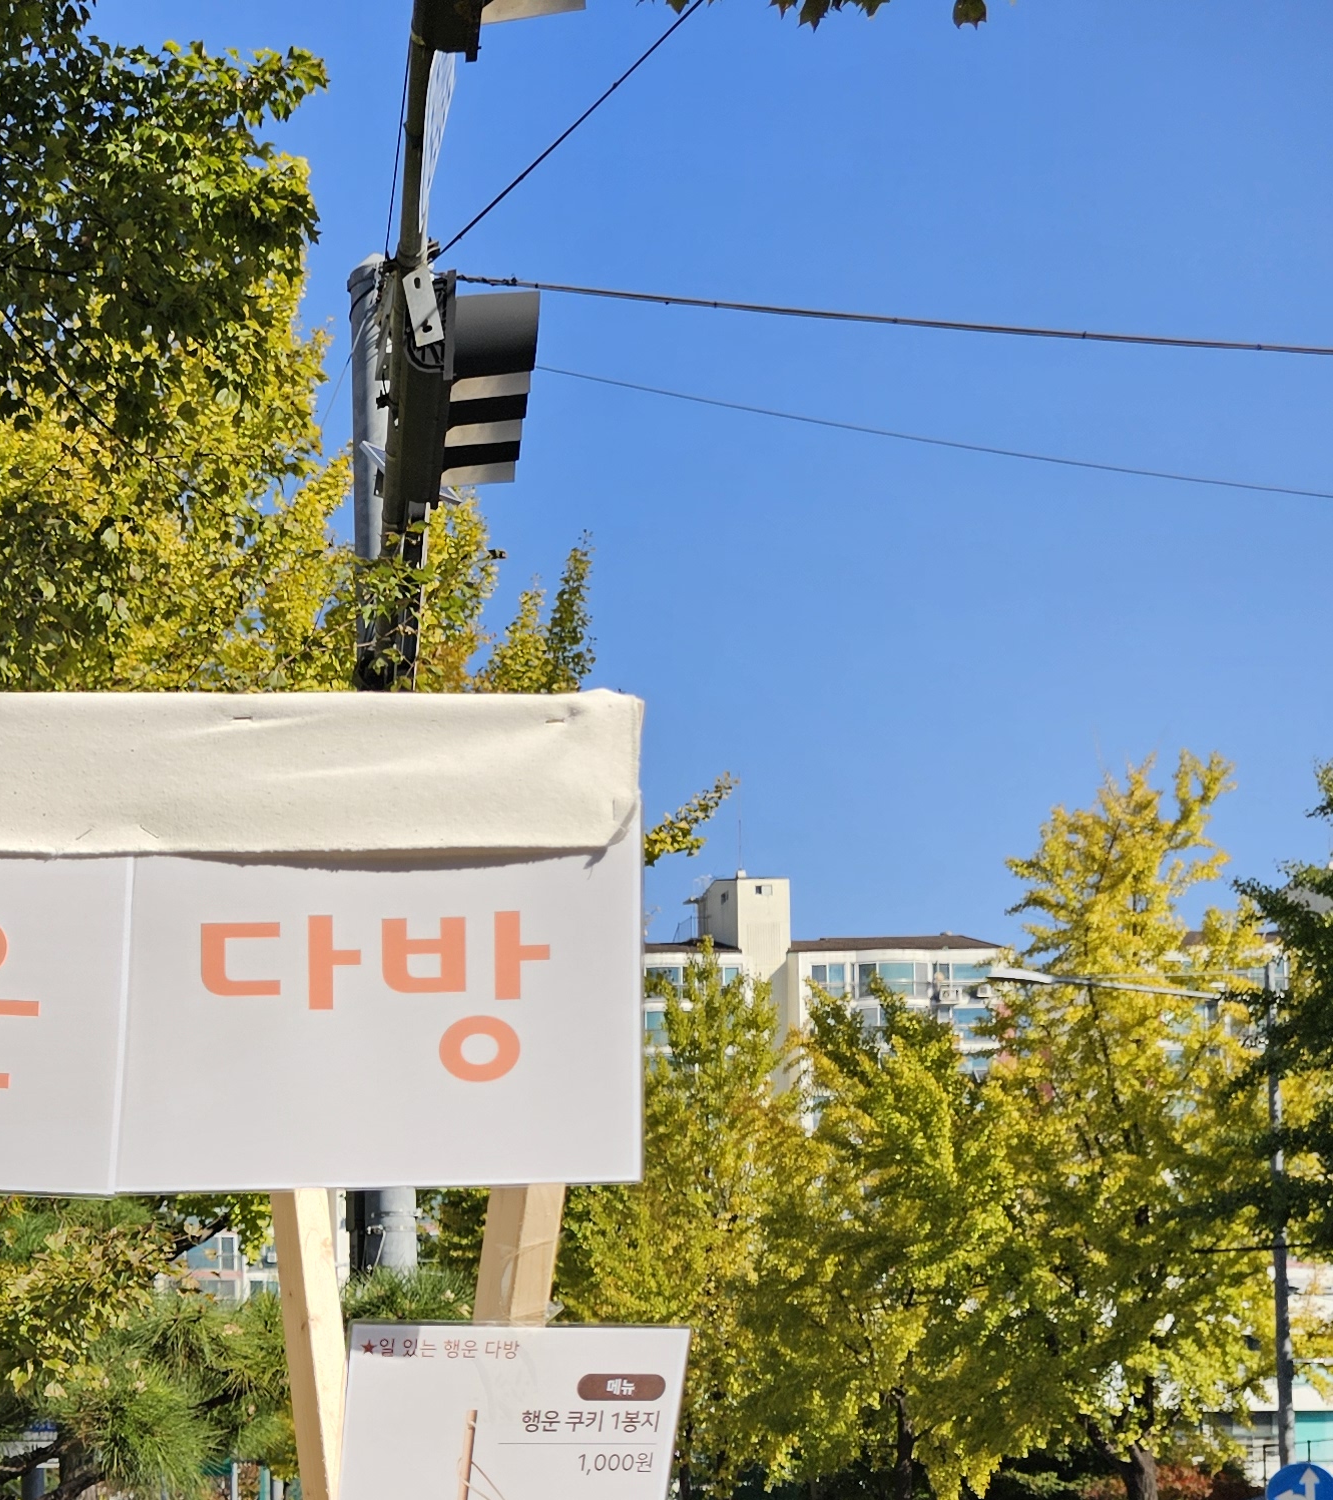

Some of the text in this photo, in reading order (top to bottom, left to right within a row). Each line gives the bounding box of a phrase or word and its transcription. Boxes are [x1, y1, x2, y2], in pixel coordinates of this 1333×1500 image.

[200, 910, 551, 1084] 다방
[379, 1338, 520, 1359] 일 있는 행운 다방
[606, 1378, 636, 1395] 메뉴
[522, 1410, 661, 1434] 행운 쿠키 1봉지
[577, 1452, 654, 1475] 1,000원
